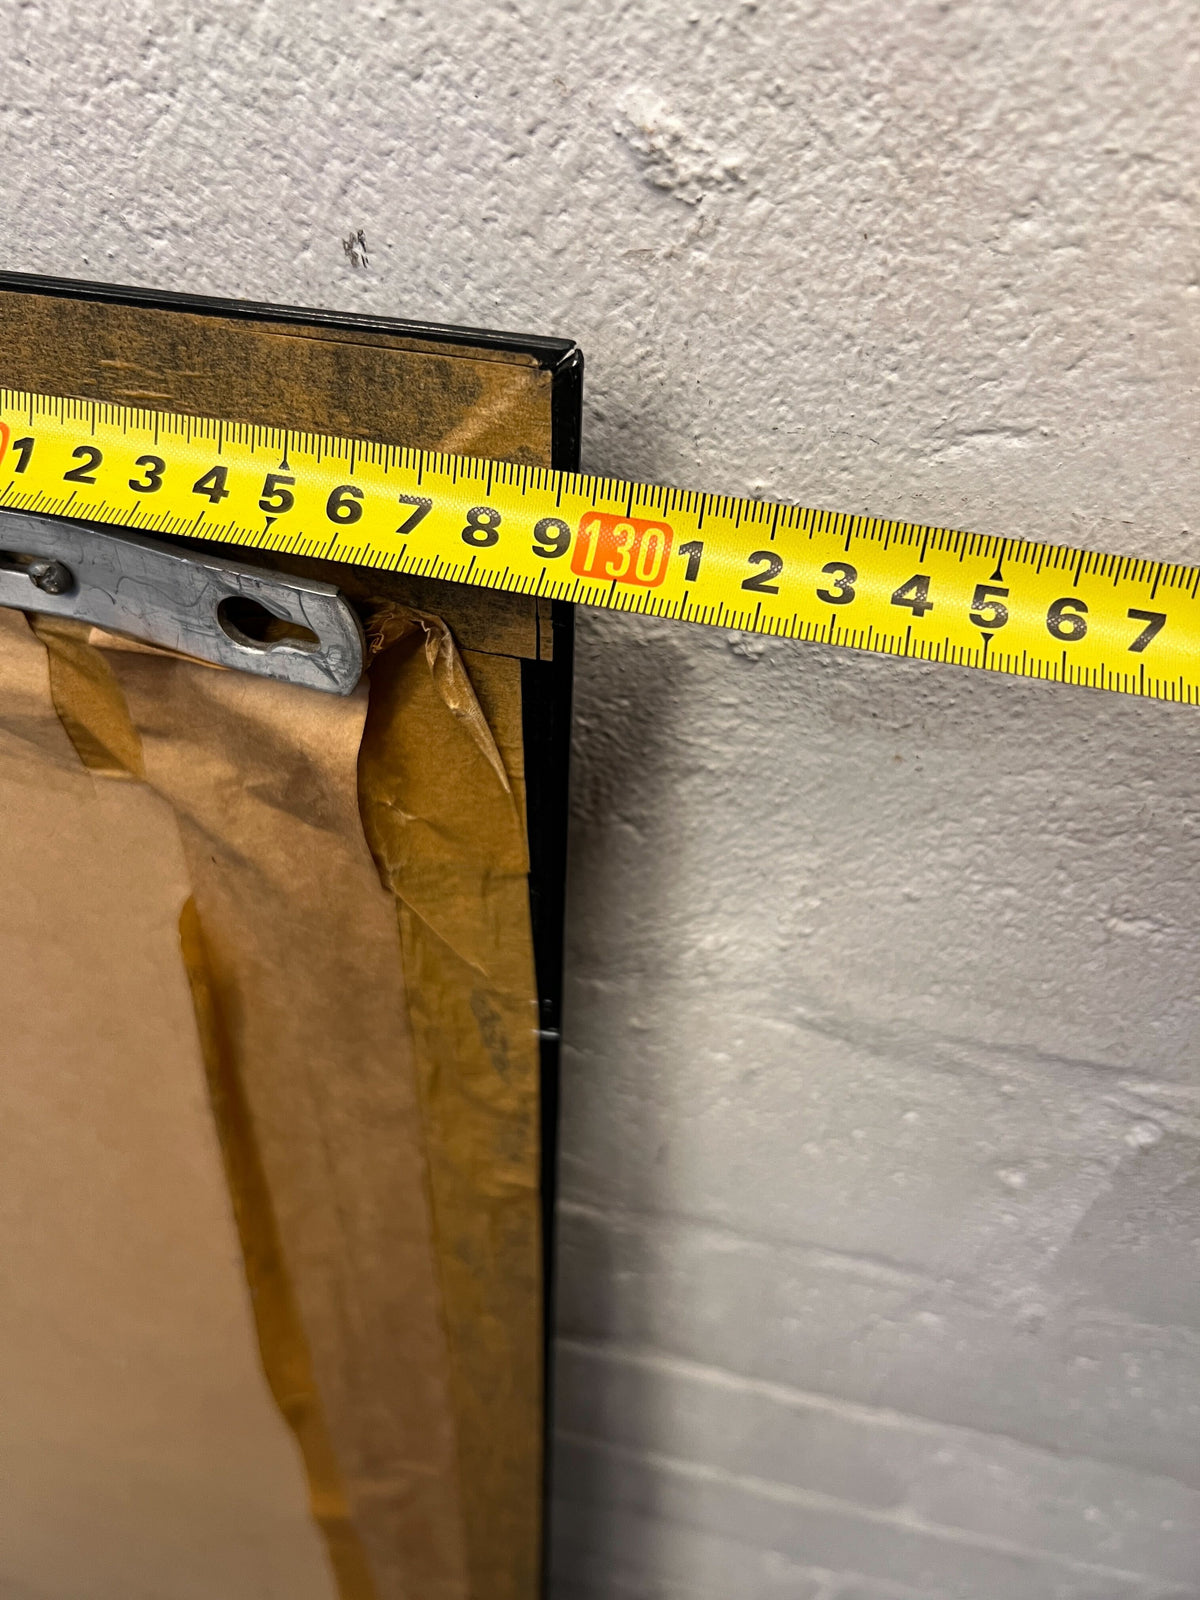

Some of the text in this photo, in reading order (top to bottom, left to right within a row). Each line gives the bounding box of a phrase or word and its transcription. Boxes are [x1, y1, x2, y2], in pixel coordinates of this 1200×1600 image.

[12, 437, 1168, 653] 1 2 3 4 5 6 7 8 9 130 1 2 3 4 5 6 7
